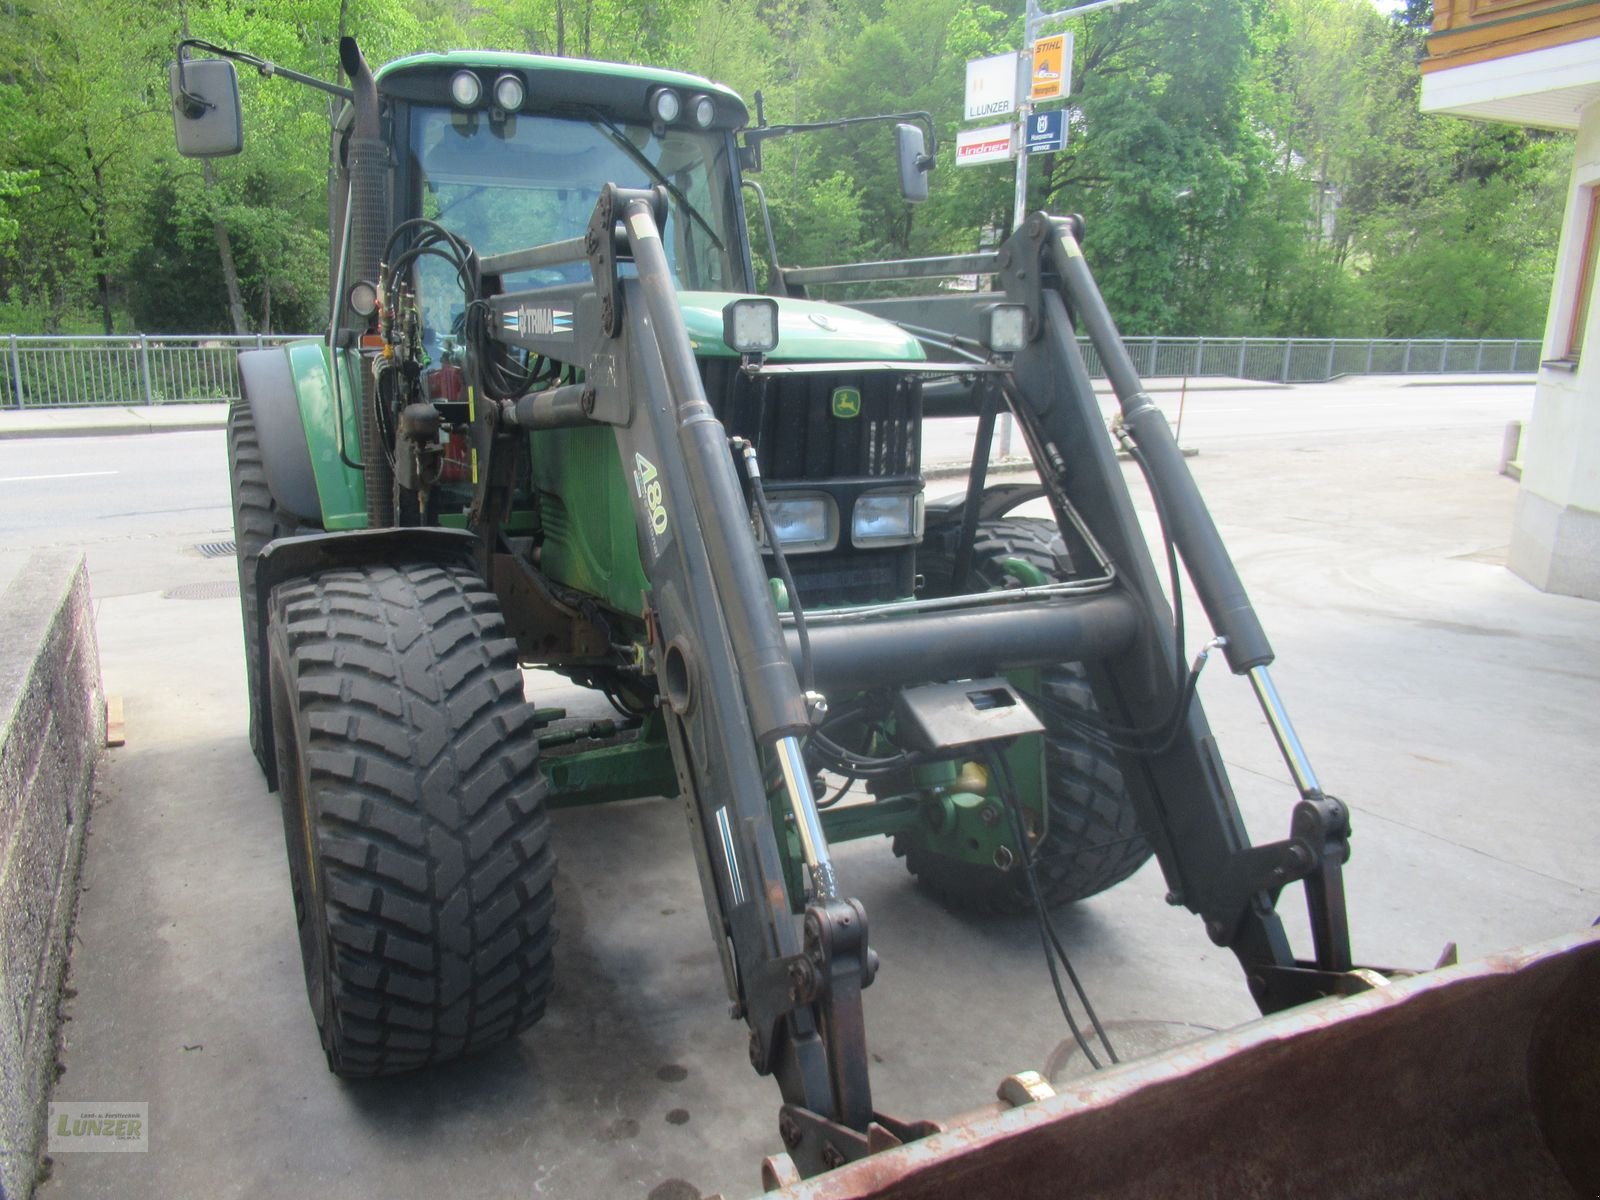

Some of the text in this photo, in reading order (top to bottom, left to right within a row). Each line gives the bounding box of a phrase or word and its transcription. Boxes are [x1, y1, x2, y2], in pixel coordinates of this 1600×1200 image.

[1036, 41, 1061, 53] STIHL
[957, 142, 1008, 157] Lindner
[526, 308, 553, 334] TRIMA
